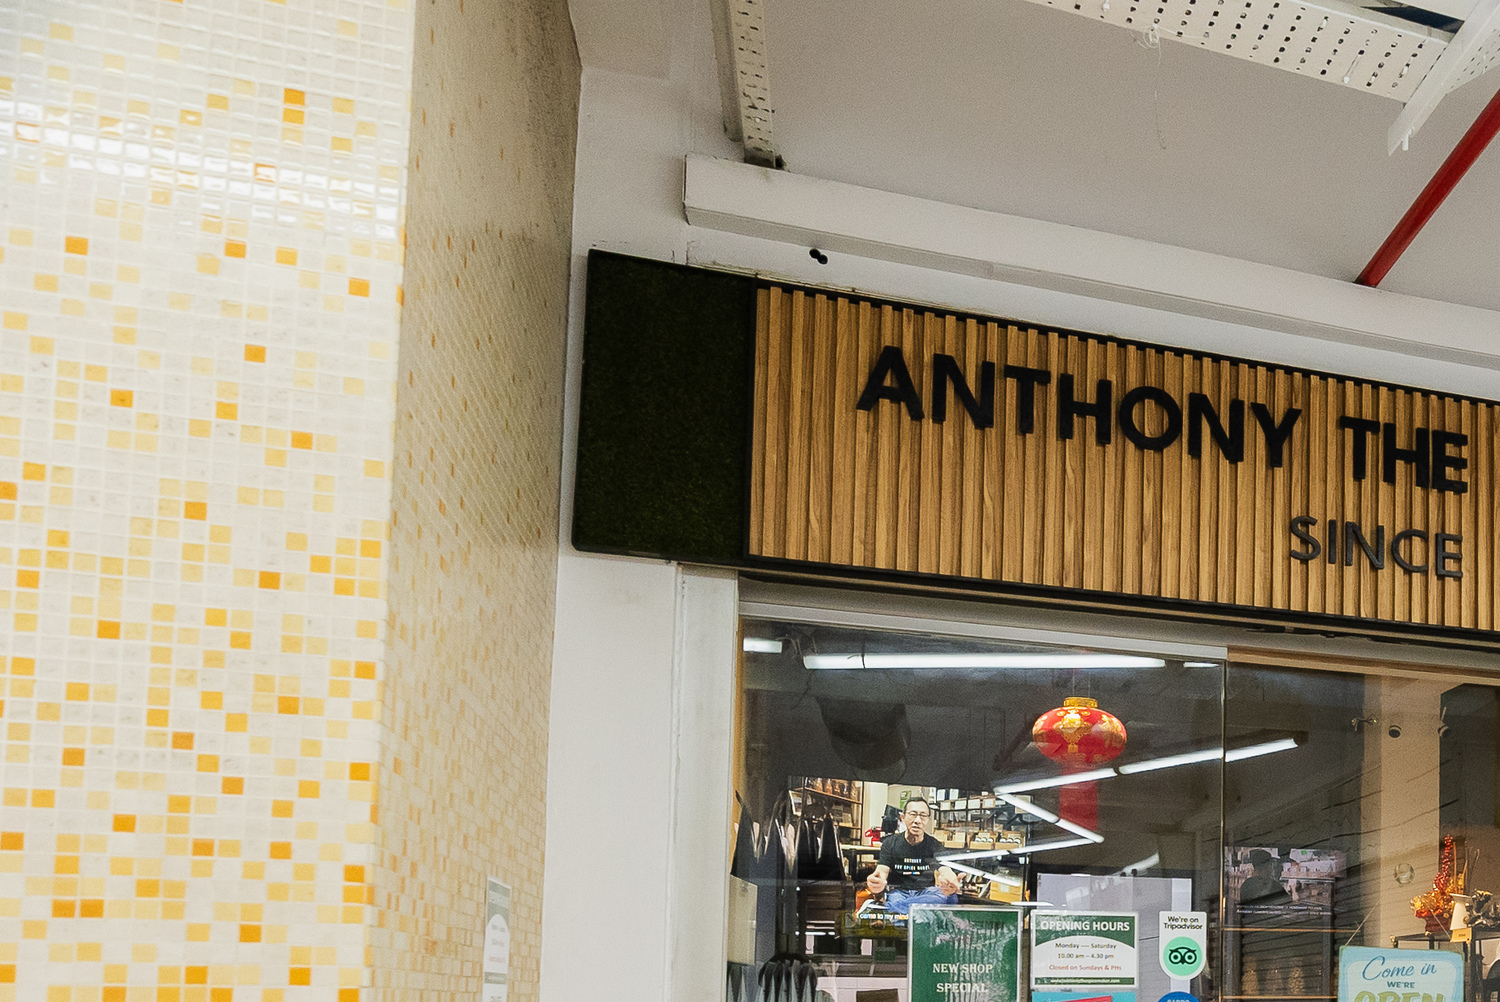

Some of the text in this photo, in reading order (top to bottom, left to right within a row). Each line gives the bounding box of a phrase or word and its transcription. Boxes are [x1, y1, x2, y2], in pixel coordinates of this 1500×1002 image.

[856, 345, 1302, 468] ANTHONY
[1340, 415, 1468, 494] THE
[1289, 515, 1464, 578] SINCE
[1040, 920, 1130, 931] OPENING HOURS
[1163, 922, 1203, 930] Tripadvisor
[932, 963, 993, 974] NEW SHOP
[1362, 955, 1437, 981] Come in
[936, 983, 988, 993] SPECIAL
